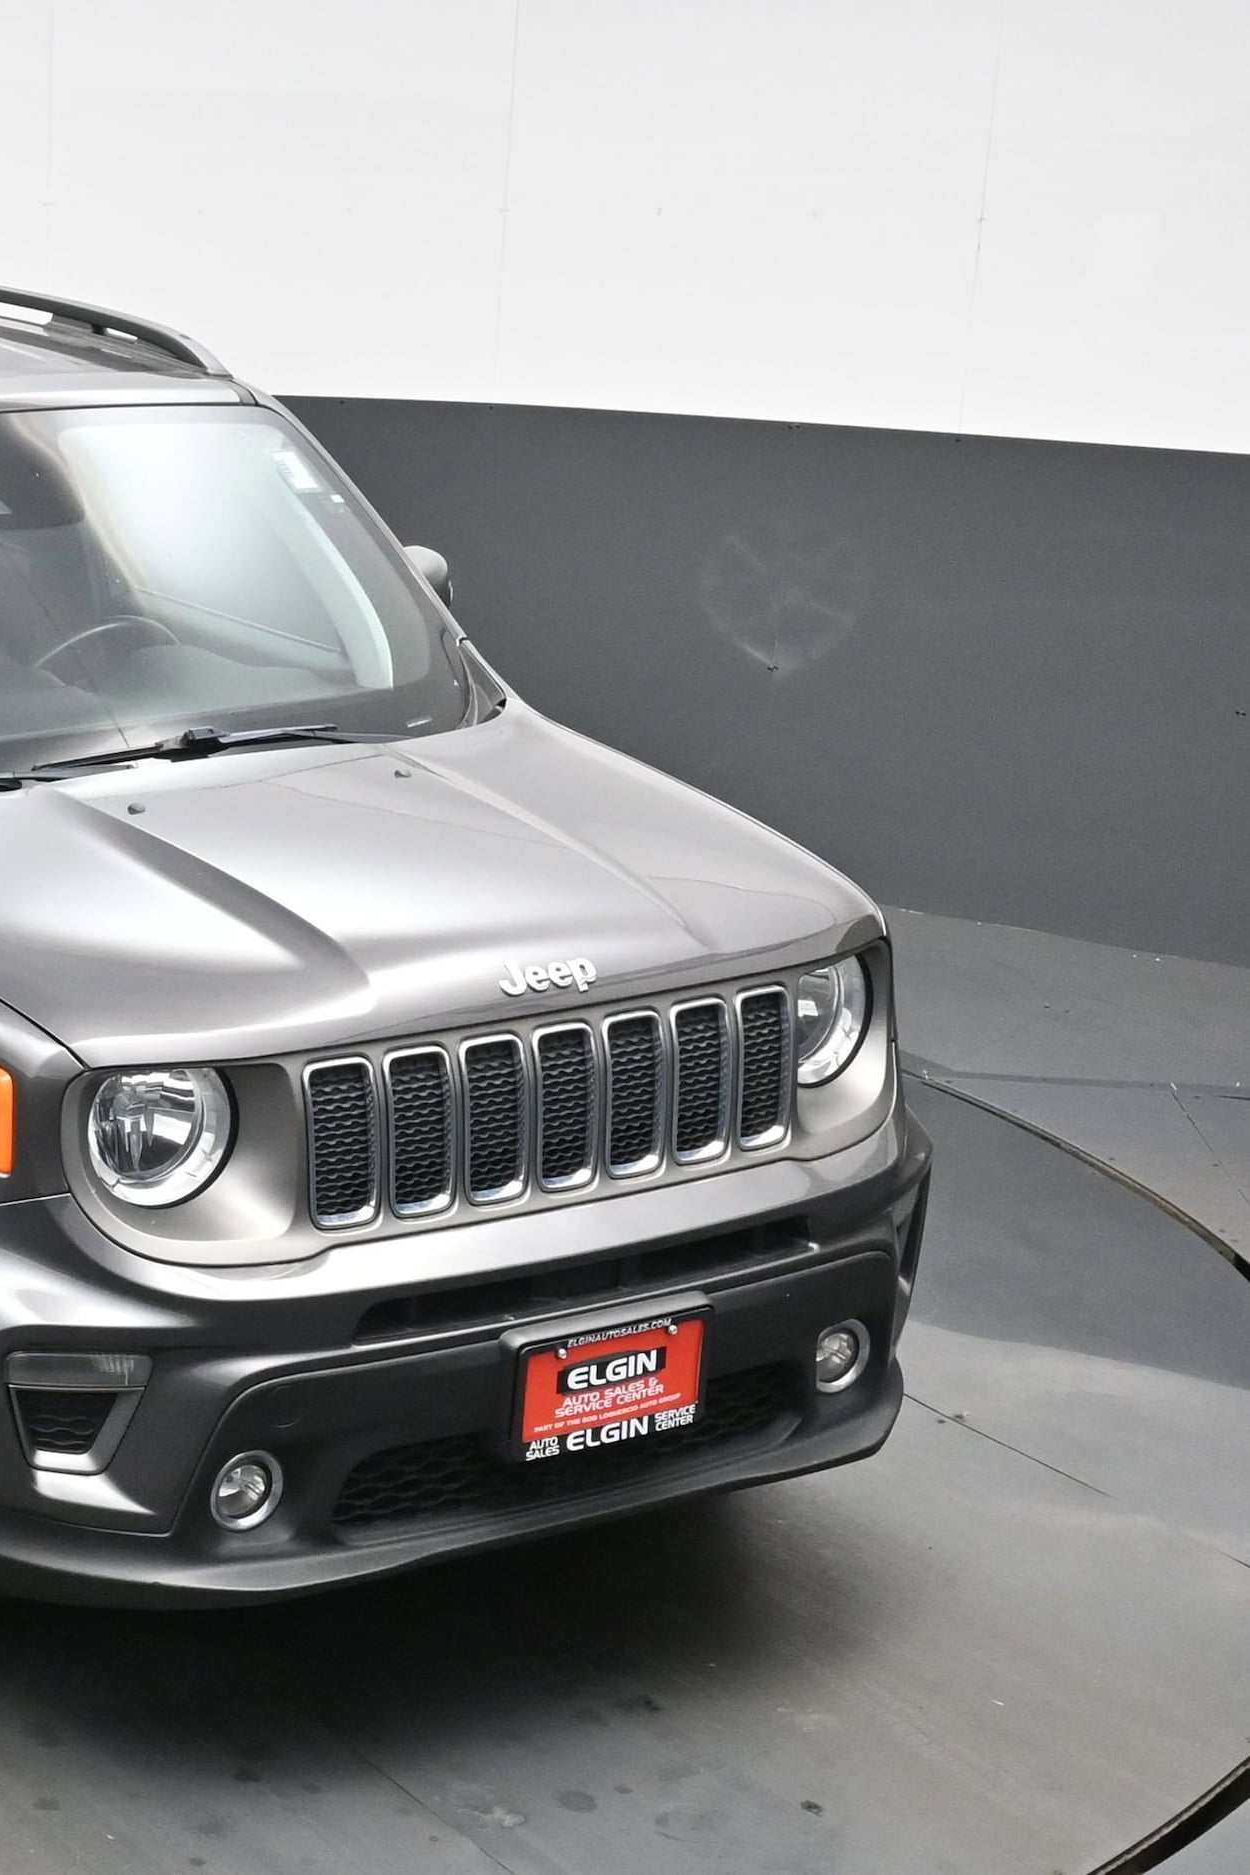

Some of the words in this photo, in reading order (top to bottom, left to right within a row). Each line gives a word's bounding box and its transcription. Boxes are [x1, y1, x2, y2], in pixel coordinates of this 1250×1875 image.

[498, 957, 597, 997] Jeep
[567, 1318, 672, 1348] ELGINAUTOSALES.COM
[566, 1349, 658, 1390] ELGIN
[554, 1398, 614, 1418] SERVICE
[616, 1384, 665, 1405] CENTER
[562, 1391, 601, 1408] AUTO
[604, 1380, 645, 1401] SALES
[648, 1376, 658, 1387] &
[534, 1423, 553, 1433] PART
[554, 1421, 566, 1429] OF
[566, 1418, 581, 1426] THE
[639, 1399, 658, 1409] AUTO
[654, 1404, 696, 1422] SERVICE
[655, 1415, 694, 1431] CENTER
[528, 1436, 559, 1451] AUTO
[566, 1416, 649, 1451] ELGIN
[525, 1447, 560, 1461] SALES
